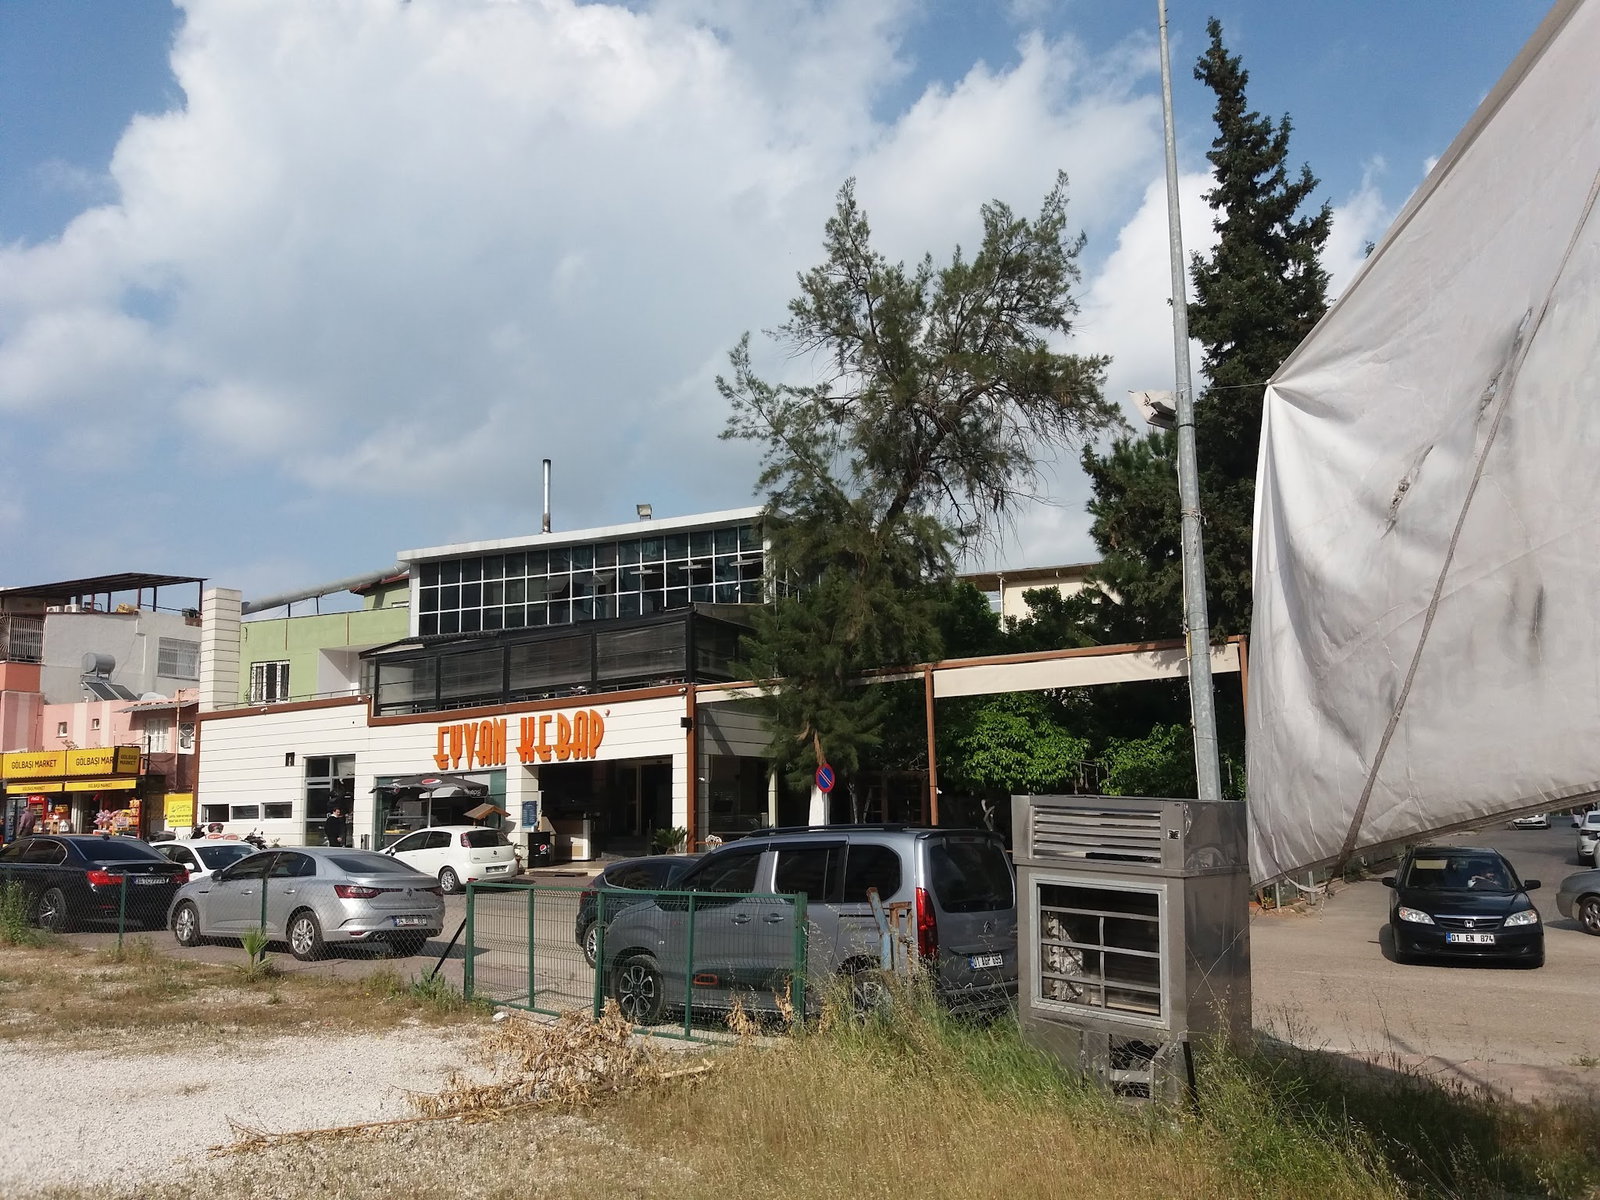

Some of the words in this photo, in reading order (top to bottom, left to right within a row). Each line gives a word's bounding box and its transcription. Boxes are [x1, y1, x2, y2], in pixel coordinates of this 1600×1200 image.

[433, 717, 507, 771] EYVAN
[515, 709, 605, 764] KEBAP
[11, 760, 34, 770] GÖLBAŞI
[34, 759, 57, 768] MARKET
[75, 756, 100, 766] GÖLBAŞI
[1451, 934, 1460, 942] 01
[1465, 934, 1475, 942] EN
